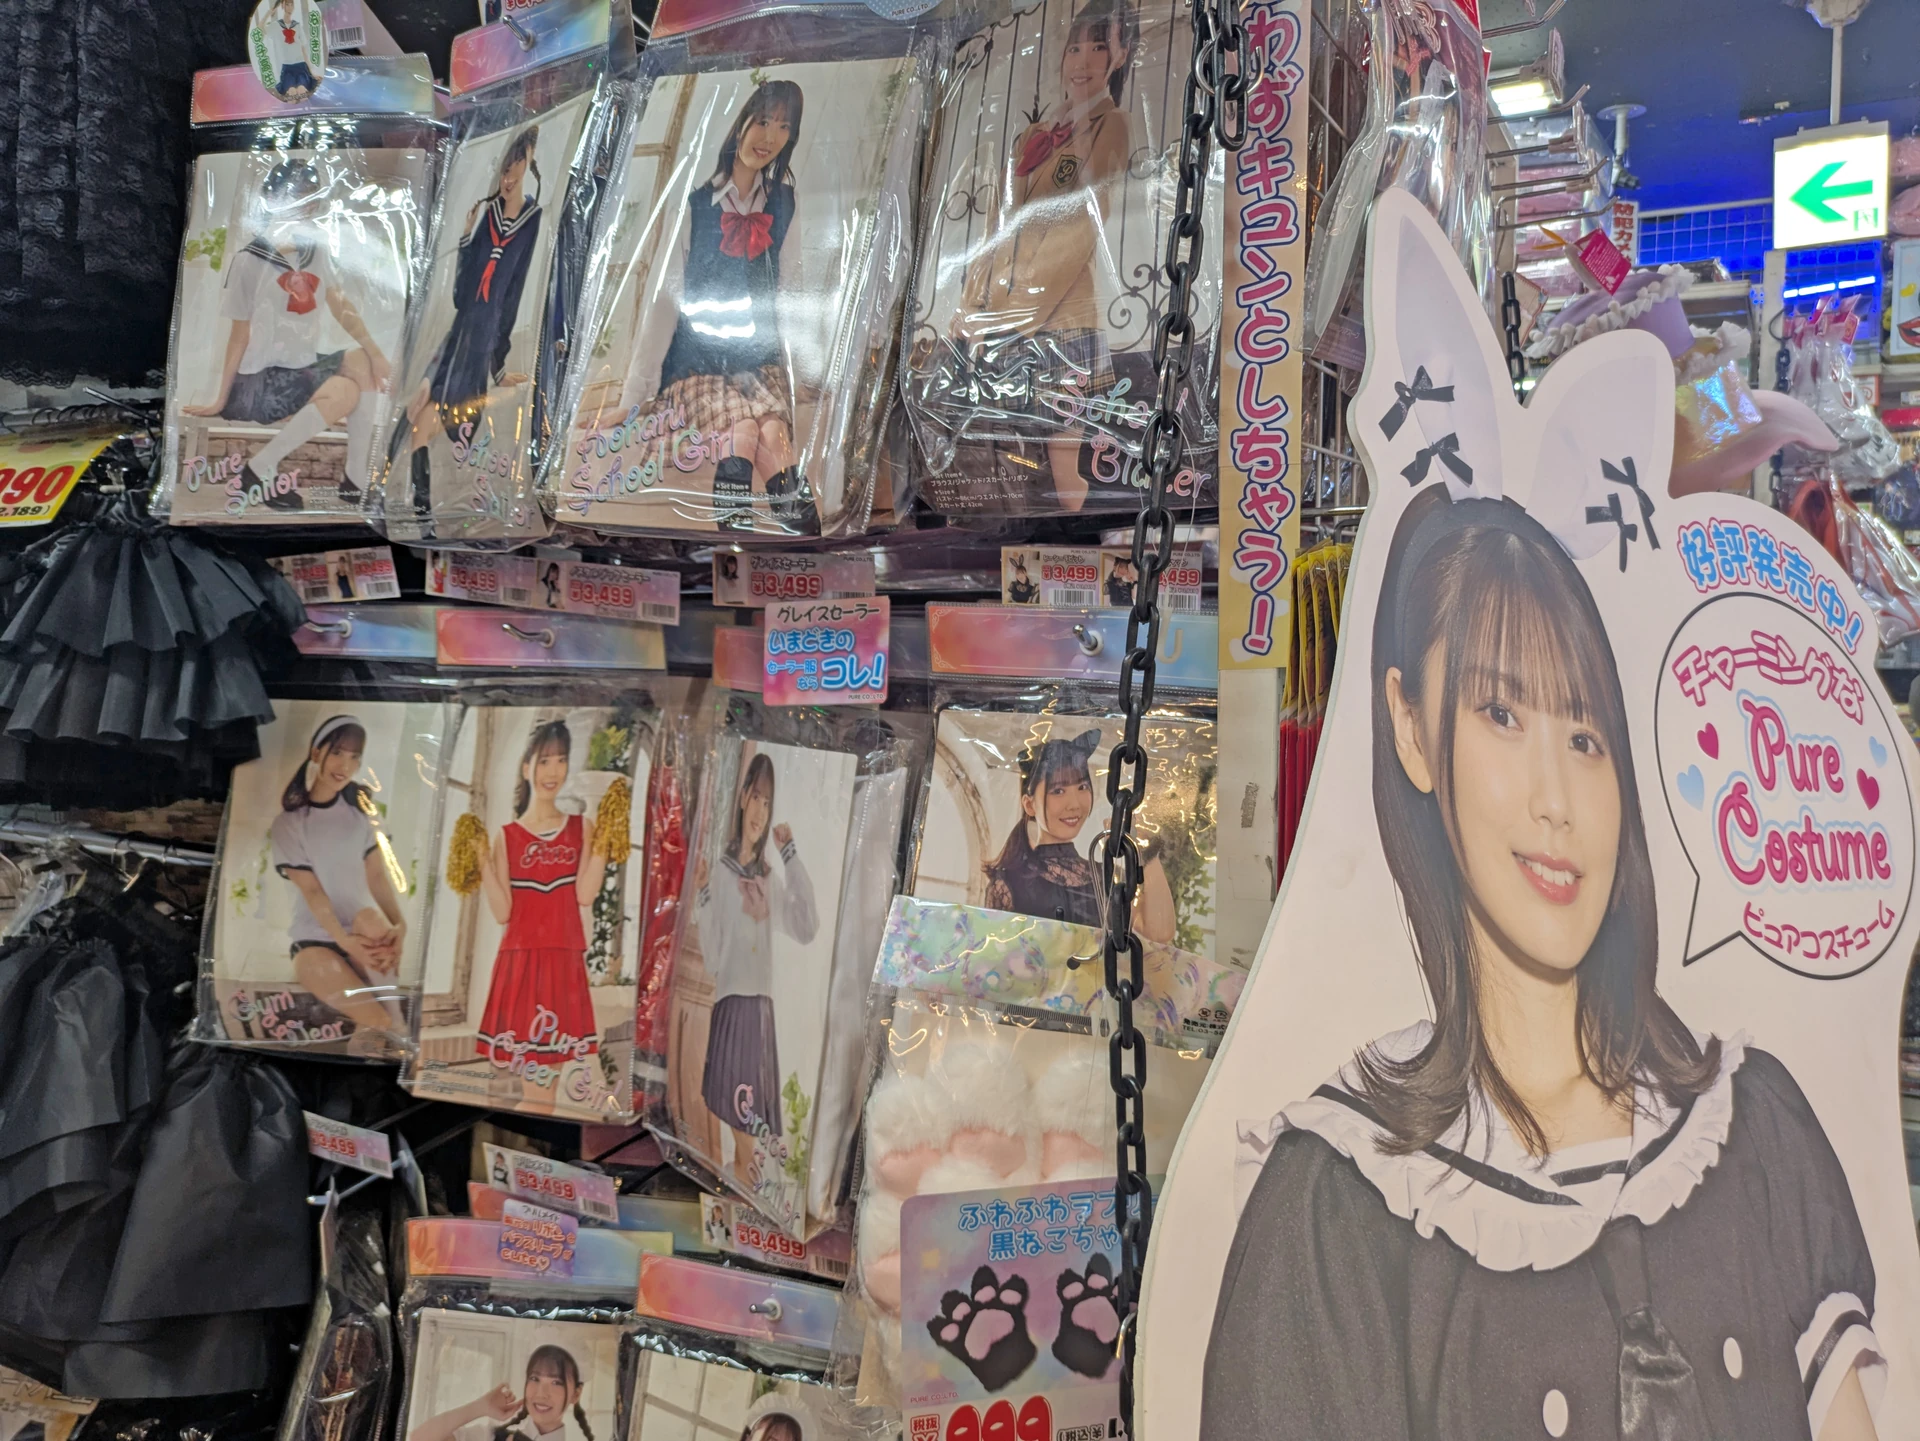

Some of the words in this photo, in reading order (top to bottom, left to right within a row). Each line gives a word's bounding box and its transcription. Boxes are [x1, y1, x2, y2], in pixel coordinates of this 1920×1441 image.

[308, 10, 321, 67] なりきり
[1613, 203, 1634, 260] 防犯カメ
[1052, 370, 1189, 429] Schol
[183, 452, 244, 492] Pure
[224, 466, 301, 517] Sailor
[567, 441, 664, 516] School
[671, 416, 736, 473] Girl
[1090, 427, 1212, 499] Blaer
[750, 556, 817, 571] グレイスセーラー
[1678, 518, 1864, 655] 好評発売中!
[767, 627, 855, 655] いまどきの
[777, 603, 880, 624] グレイスセーラー
[766, 659, 819, 675] セーラー服
[796, 676, 819, 691] なら
[820, 652, 887, 691] コレ!
[1672, 630, 1864, 725] チャーミングな
[1742, 698, 1844, 793] Pure
[1718, 780, 1892, 886] Costume
[1743, 899, 1896, 961] ピュアコスチューム
[489, 1030, 561, 1089] Cheer
[530, 1004, 590, 1061] Pure
[733, 1083, 788, 1167] Grace
[912, 1415, 939, 1432] 税抜
